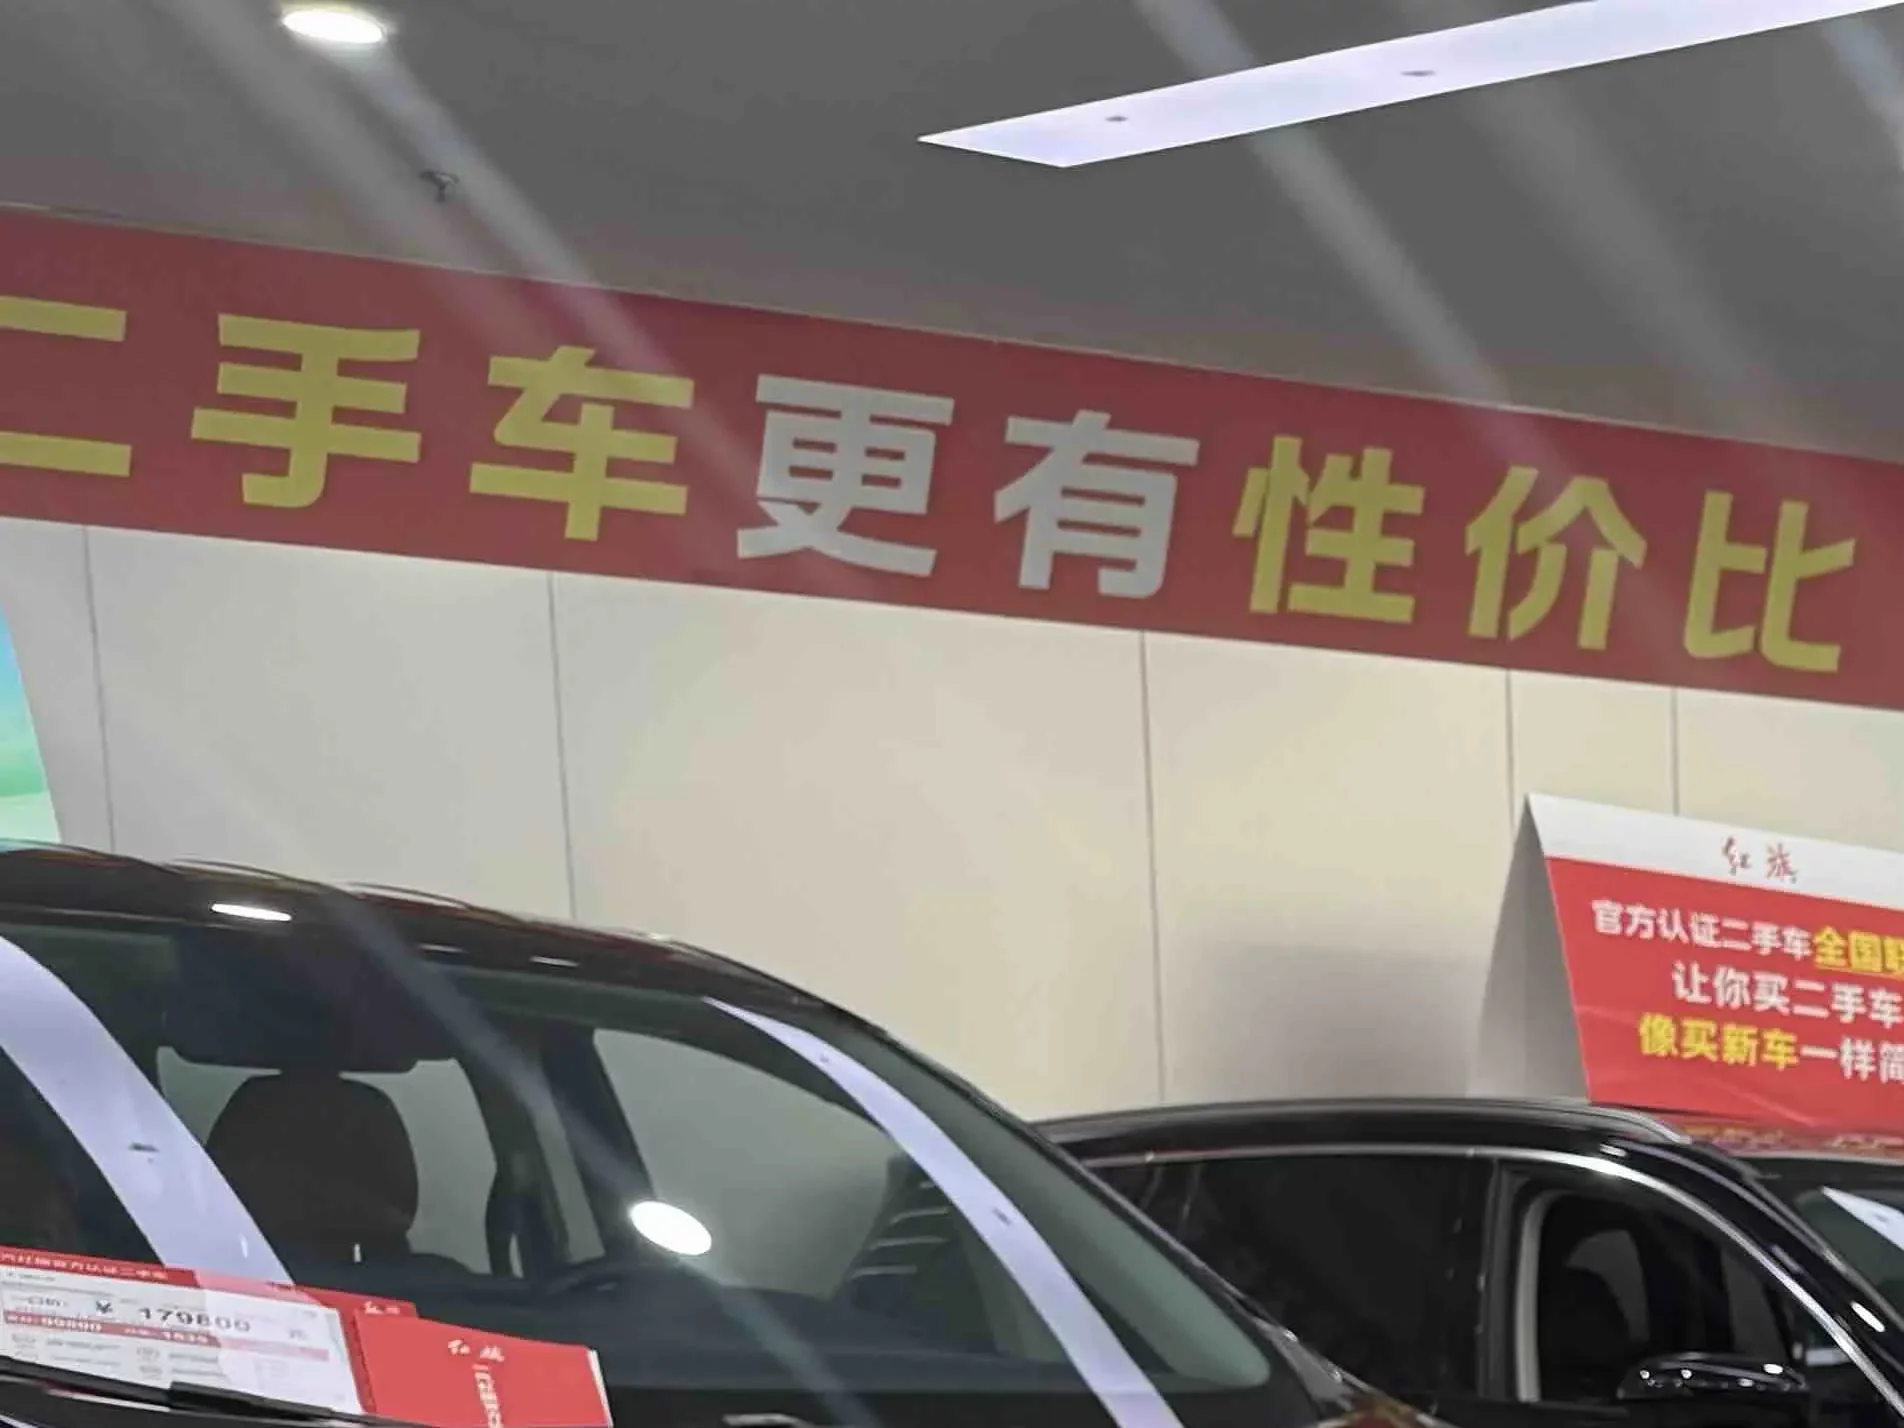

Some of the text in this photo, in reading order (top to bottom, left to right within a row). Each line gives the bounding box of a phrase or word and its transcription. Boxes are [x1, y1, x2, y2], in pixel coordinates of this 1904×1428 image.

[0, 296, 1867, 676] 二手车更有性价比
[1673, 962, 1904, 1028] 让你买二手车
